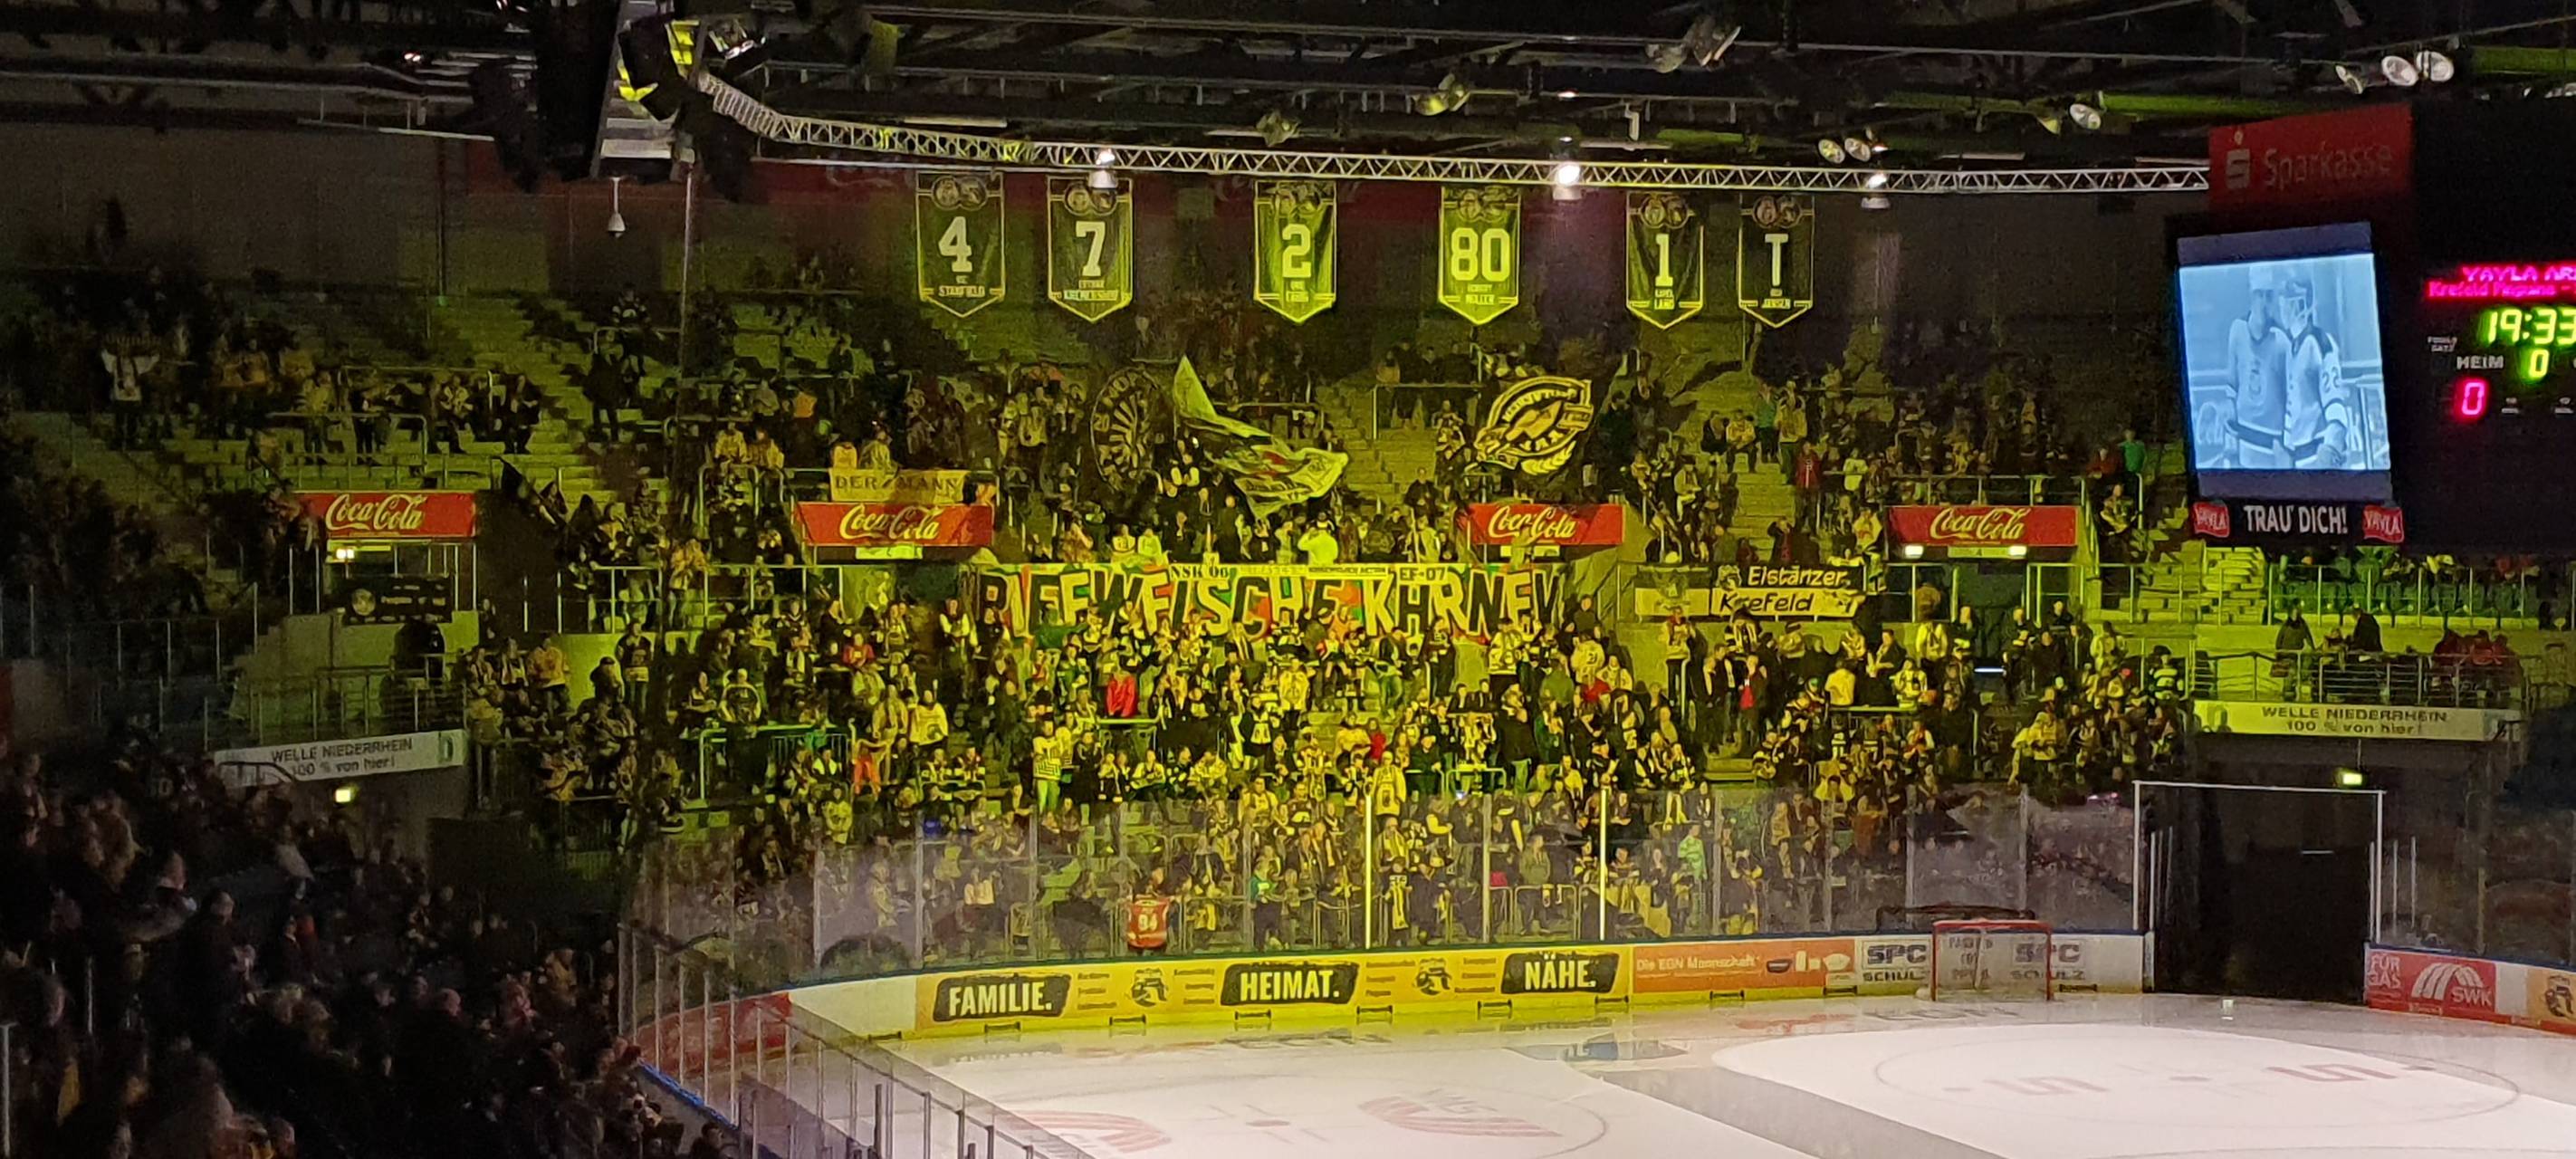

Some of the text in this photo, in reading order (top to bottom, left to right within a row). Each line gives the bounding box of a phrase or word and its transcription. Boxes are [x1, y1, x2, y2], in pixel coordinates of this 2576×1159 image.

[2265, 141, 2392, 192] Sparkasse
[938, 216, 972, 273] 4
[1076, 221, 1106, 276] 7
[1282, 224, 1311, 278] 2
[1451, 227, 1510, 282] 80
[1655, 234, 1673, 286] 1
[1765, 234, 1788, 286] T
[2489, 309, 2576, 345] 19:33
[2456, 355, 2504, 369] HEIM
[2529, 349, 2549, 378] 0
[2461, 381, 2485, 416] 0
[325, 494, 427, 531] Coca-Cola
[838, 504, 943, 541] Coca-Cola
[1929, 508, 2032, 541] Coca-Cola
[2299, 506, 2349, 534] DICH!
[2263, 706, 2447, 722] WELLE NIEDERRHEIN
[2287, 721, 2316, 732] 100
[2343, 724, 2374, 733] von
[272, 738, 413, 762] WELLE NIEDERRHEIN
[335, 761, 359, 771] von
[1637, 960, 1654, 972] Die
[1867, 944, 1926, 964] SPC
[1240, 970, 1340, 1001] HEIMAT.
[1525, 953, 1596, 990] NÄHE.
[950, 982, 1052, 1016] FAMILIE.
[2452, 986, 2492, 1006] SWK
